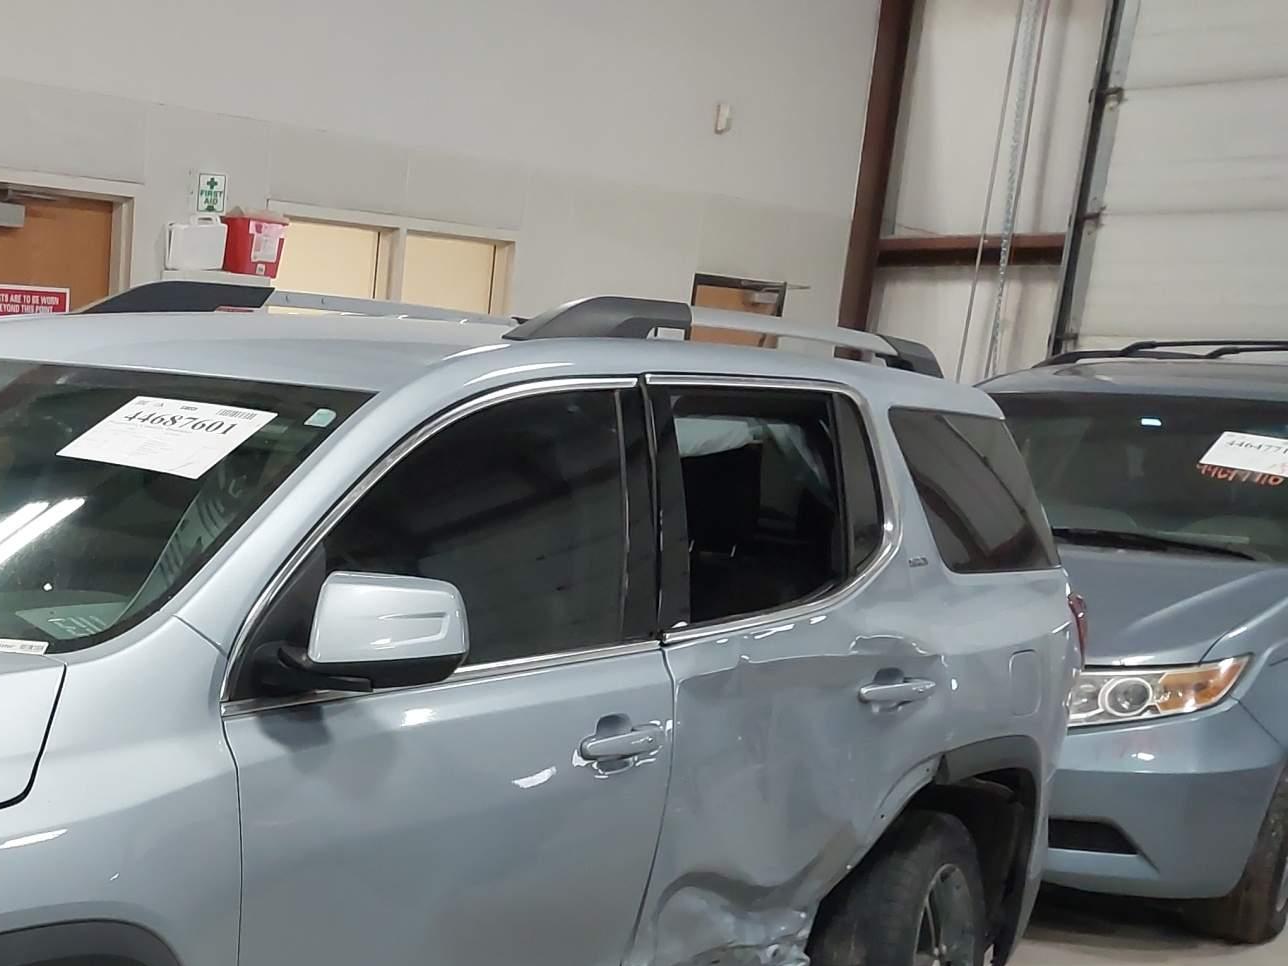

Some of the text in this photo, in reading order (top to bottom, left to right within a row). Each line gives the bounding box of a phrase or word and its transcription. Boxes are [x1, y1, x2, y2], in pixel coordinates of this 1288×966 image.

[200, 190, 223, 198] FIRST
[10, 294, 22, 304] ARE
[23, 295, 31, 304] TO
[32, 295, 40, 304] BE
[40, 296, 60, 305] WORN
[21, 304, 35, 313] THIS
[35, 305, 54, 314] POINT
[123, 410, 237, 435] 44687601
